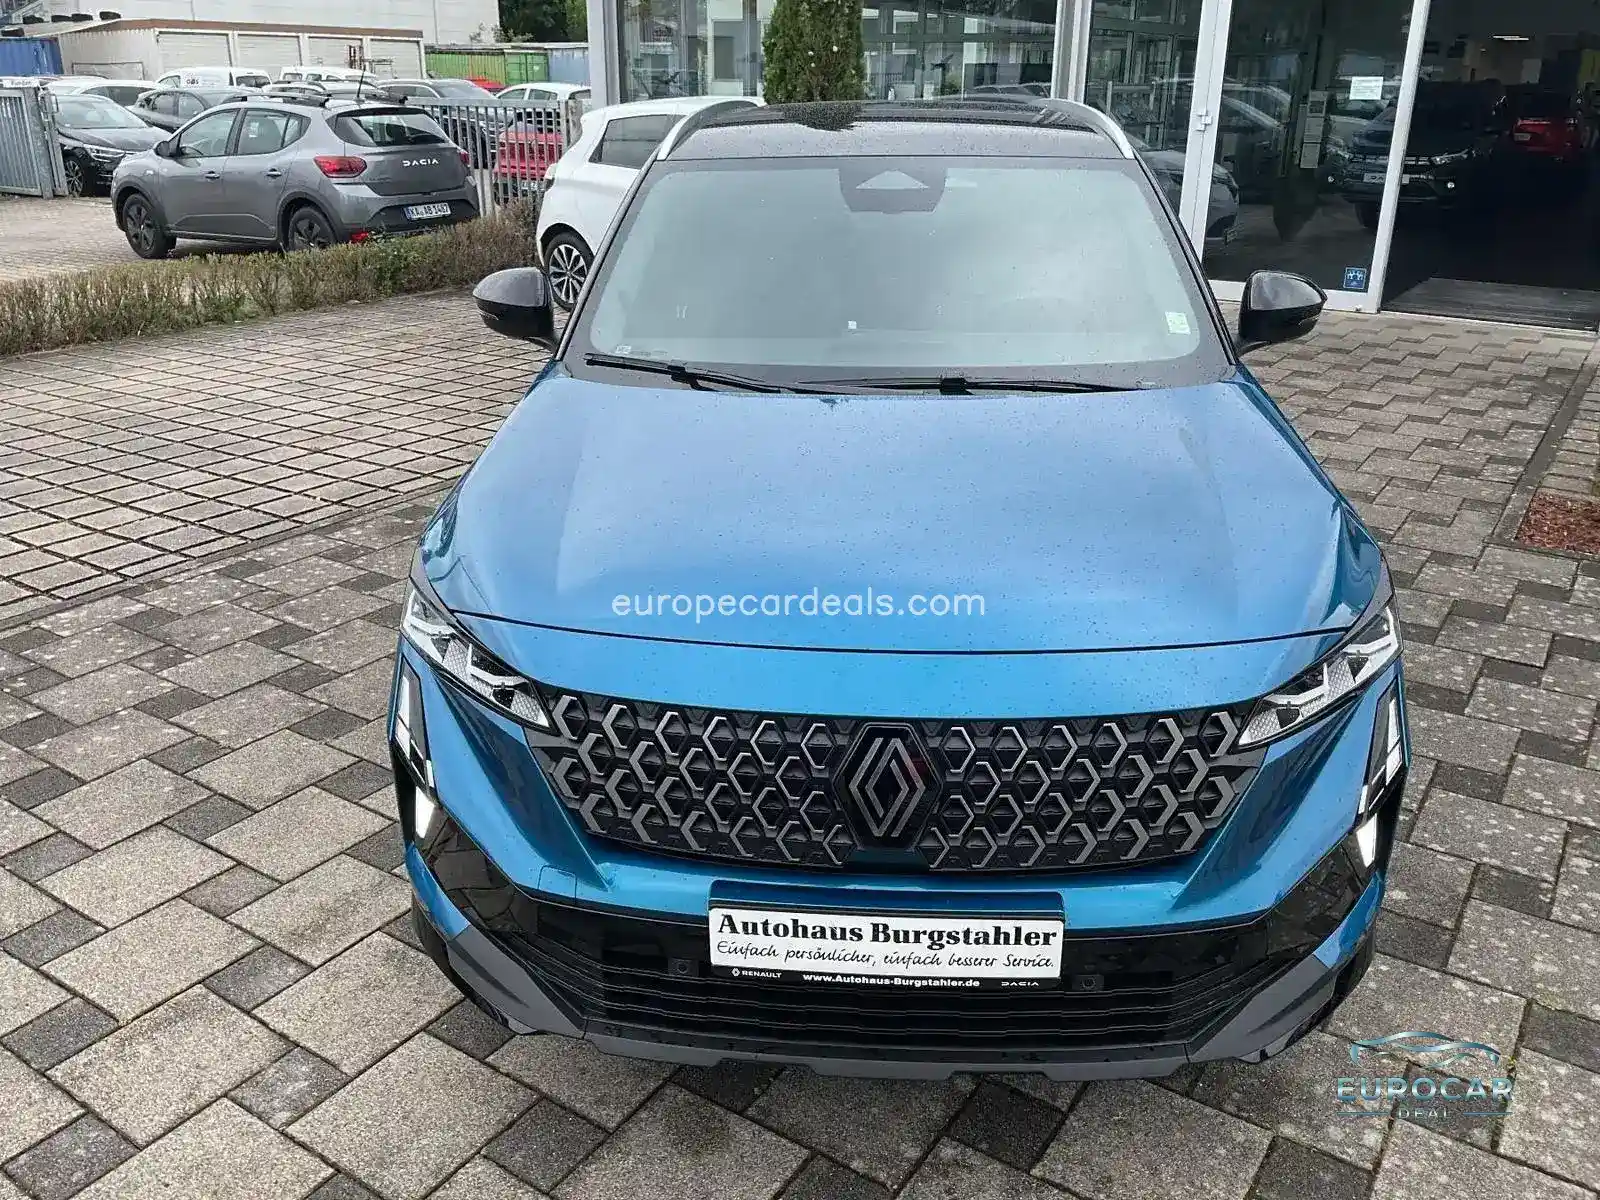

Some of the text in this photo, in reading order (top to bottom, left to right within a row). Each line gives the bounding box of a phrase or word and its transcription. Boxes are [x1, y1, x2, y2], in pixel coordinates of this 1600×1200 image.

[402, 158, 439, 167] DACIA
[717, 914, 1057, 951] Autohaus Burgstahler
[717, 940, 1055, 969] Einfach persönlicher, einfach besserer Service.
[741, 969, 1040, 988] RENAULT www.Autohaus-Burgstahler.de DACIA
